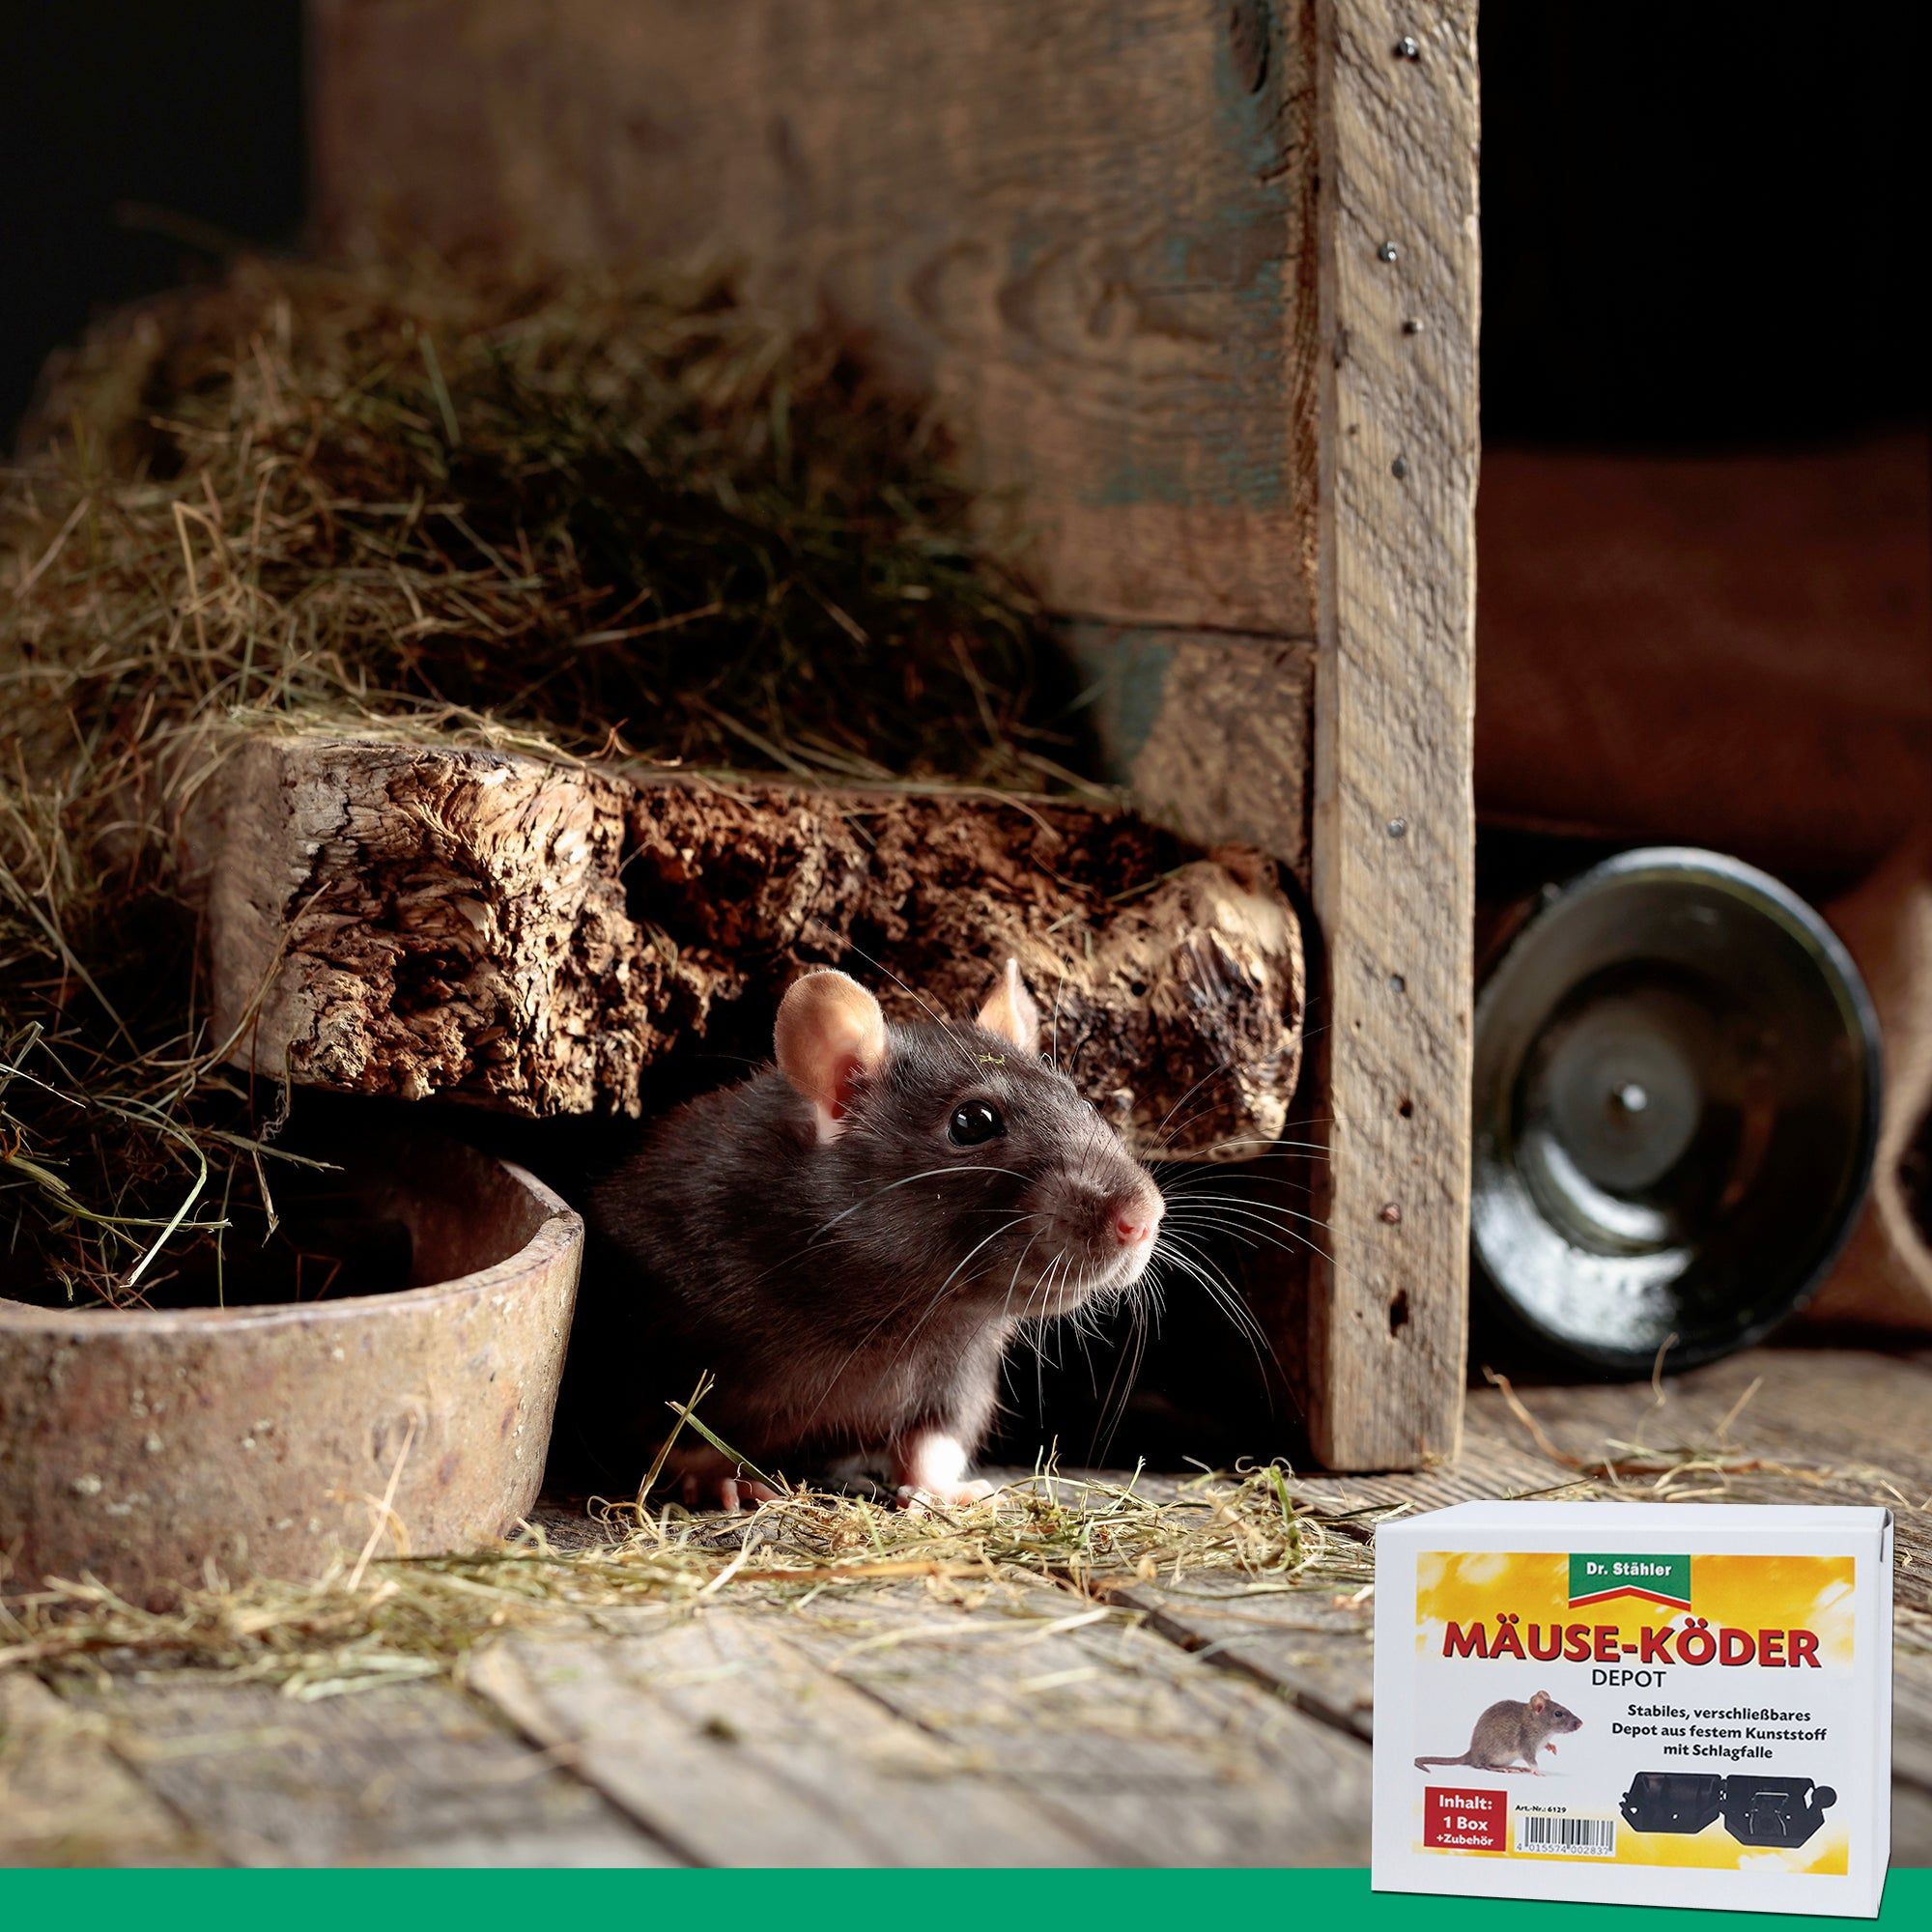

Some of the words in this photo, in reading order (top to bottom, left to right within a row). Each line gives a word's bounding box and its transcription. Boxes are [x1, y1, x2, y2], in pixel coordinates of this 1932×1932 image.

[1586, 1562, 1608, 1576] Dr.
[1613, 1562, 1672, 1577] Stähler
[1442, 1613, 1822, 1668] MÄUSE-KÖDER
[1592, 1669, 1666, 1688] DEPOT
[1628, 1704, 1690, 1719] Stabiles,
[1693, 1707, 1811, 1721] verschließbares
[1612, 1723, 1658, 1738] Depot
[1661, 1726, 1686, 1737] aus
[1690, 1724, 1742, 1738] festem
[1746, 1727, 1827, 1740] Kunststoff
[1663, 1744, 1690, 1755] mit
[1692, 1745, 1773, 1761] Schlagfalle
[1439, 1795, 1492, 1809] Inhalt:
[1443, 1817, 1451, 1829] 1
[1458, 1817, 1488, 1831] Box
[1436, 1833, 1493, 1846] +Zubehör
